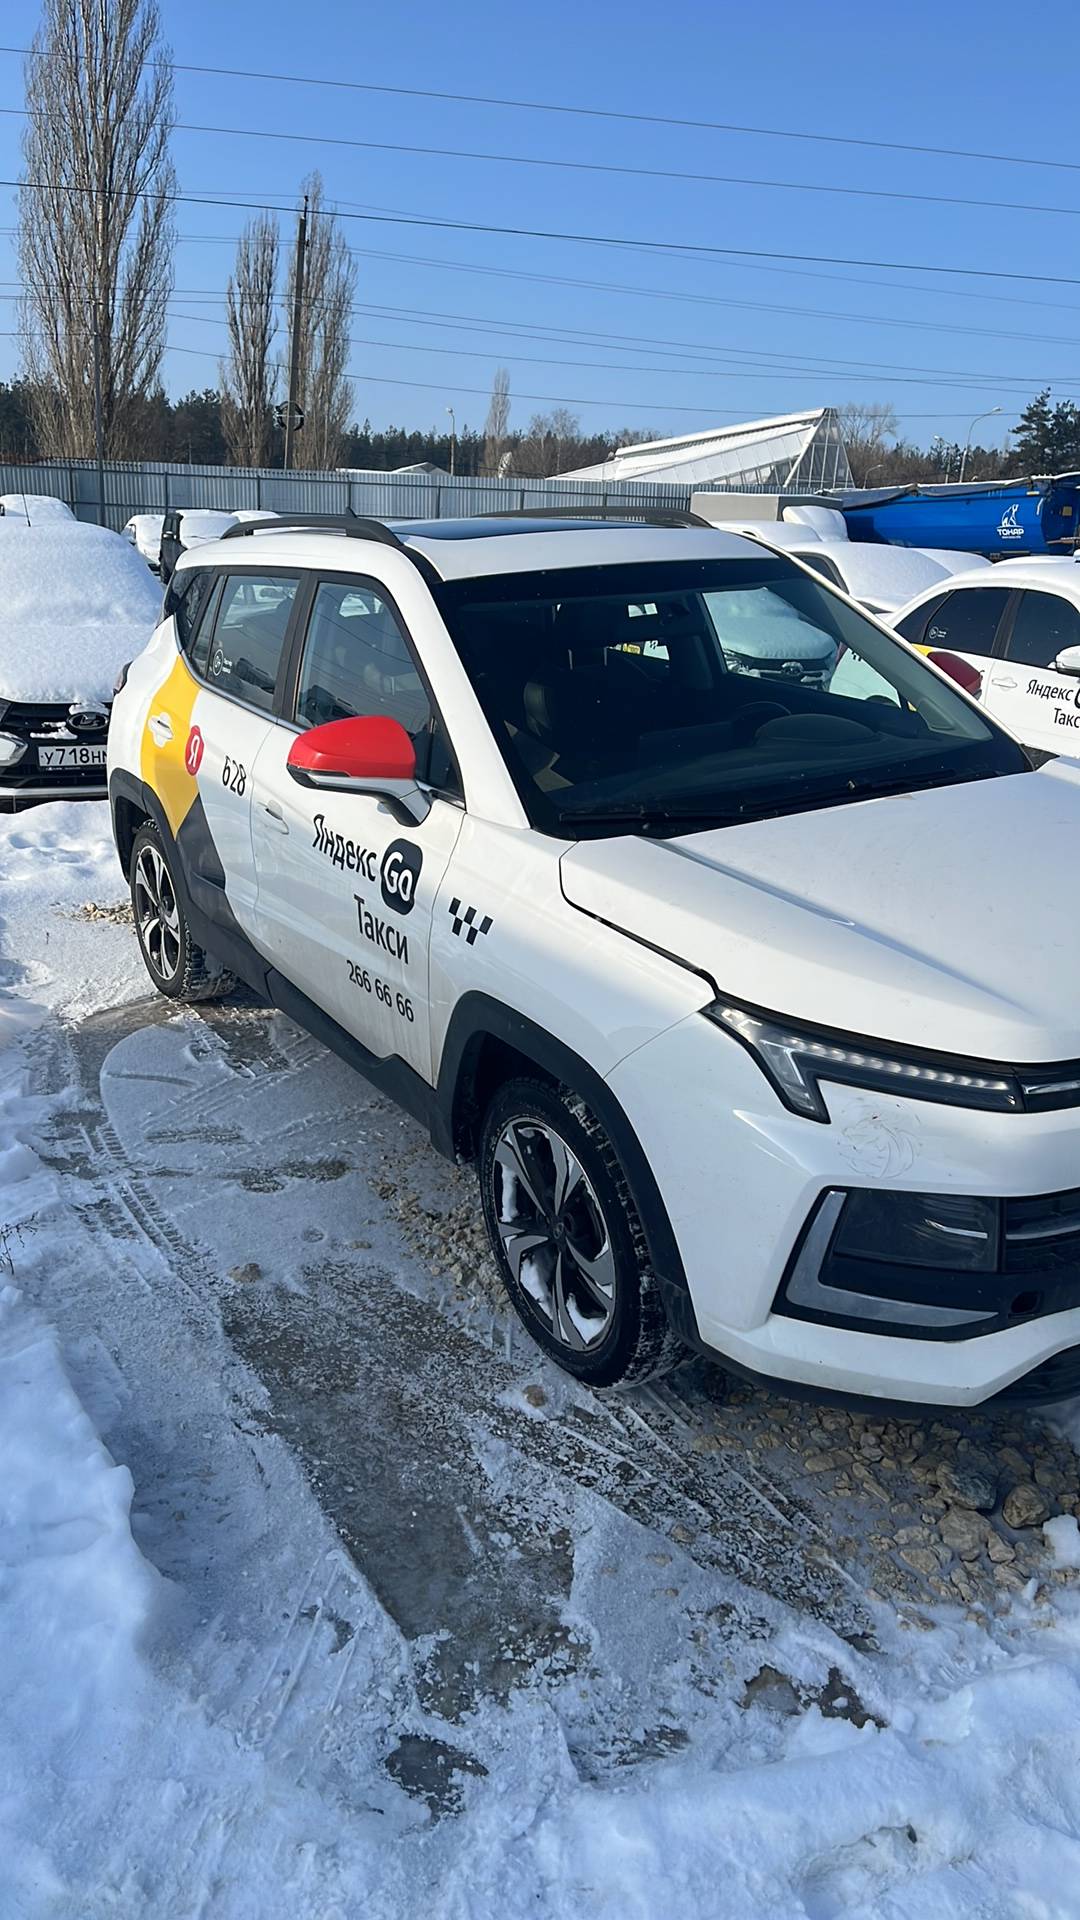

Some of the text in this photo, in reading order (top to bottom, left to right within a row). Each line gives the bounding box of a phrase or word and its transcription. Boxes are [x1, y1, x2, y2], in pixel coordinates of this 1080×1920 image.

[1026, 679, 1074, 701] Яндекс
[188, 734, 201, 768] Я
[222, 755, 247, 797] 628
[312, 813, 413, 902] Яндекс Go
[353, 893, 409, 965] Такси
[346, 959, 415, 1021] 266 66 66
